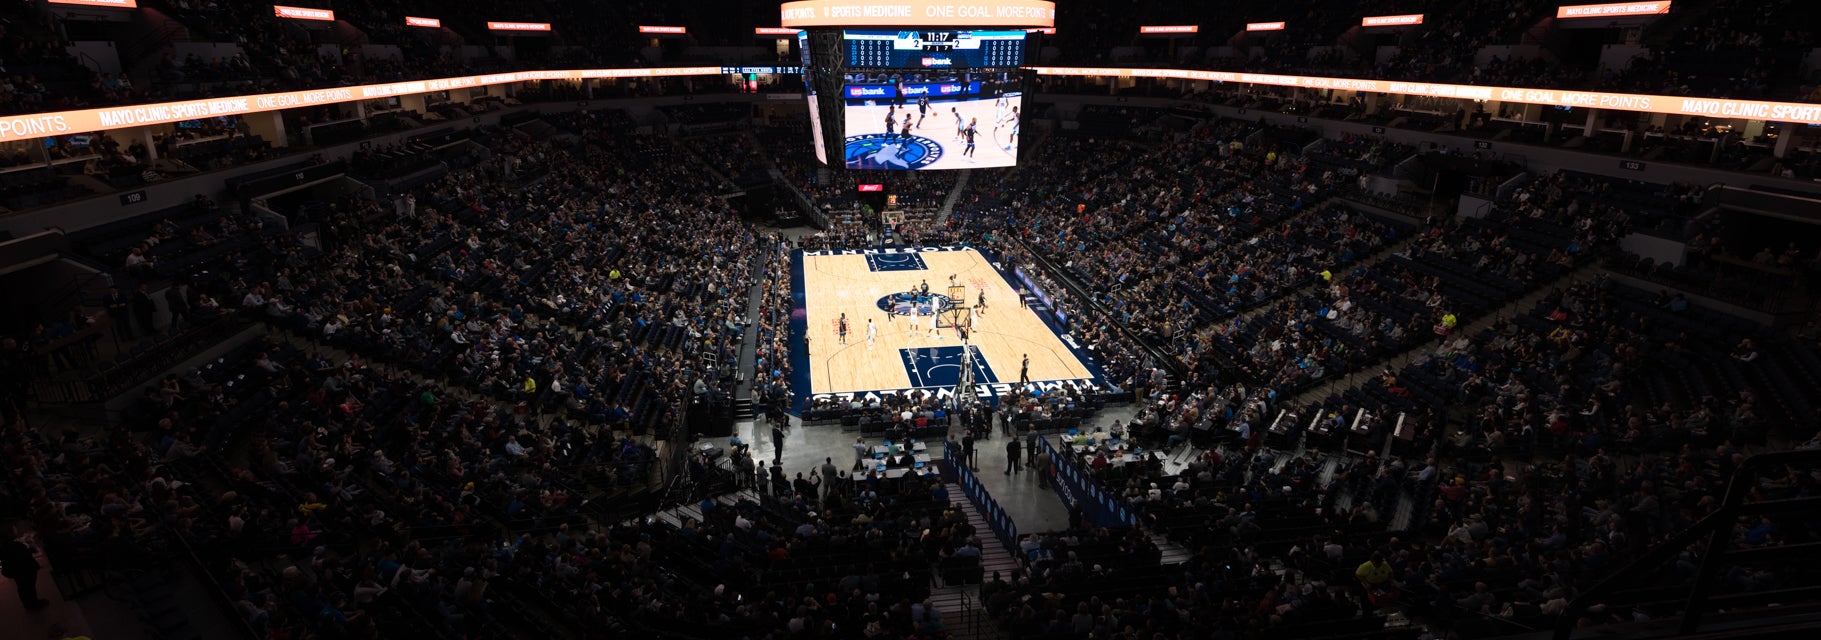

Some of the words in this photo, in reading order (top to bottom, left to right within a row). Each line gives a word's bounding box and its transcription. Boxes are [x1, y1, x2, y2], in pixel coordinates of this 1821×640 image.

[832, 6, 860, 17] SPORTS
[864, 5, 911, 17] MEDICINE
[926, 5, 954, 17] ONE
[961, 5, 993, 17] GOAL.
[996, 6, 1024, 18] MORE
[1566, 7, 1582, 15] MAYO
[1583, 7, 1602, 15] CLINIC
[1602, 5, 1627, 14] SPORTS
[1627, 3, 1660, 13] MEDICINE
[928, 32, 949, 41] 11:17
[914, 40, 919, 48] 2
[955, 40, 960, 48] 2
[1333, 80, 1350, 88] MORE
[1389, 82, 1407, 93] MAYO
[1407, 84, 1428, 95] CLINIC
[1428, 85, 1455, 96] SPORTS
[257, 97, 276, 109] ONE
[278, 94, 302, 107] GOAL.
[304, 92, 325, 105] MORE
[326, 88, 352, 101] POINTS.
[1501, 89, 1523, 101] ONE
[1526, 91, 1558, 103] GOAL.
[1561, 93, 1597, 105] MORE
[1600, 95, 1652, 109] POINTS.
[99, 110, 134, 127] MAYO
[135, 106, 171, 123] CLINIC
[171, 102, 208, 119] SPORTS
[208, 98, 248, 114] MEDICINE
[1681, 100, 1720, 114] MAYO
[1722, 102, 1769, 118] CLINIC
[1771, 105, 1821, 121] SPORT
[0, 116, 71, 138] POINTS.
[1626, 161, 1639, 170] 133
[127, 193, 141, 203] 109
[803, 246, 977, 256] MINNESOTA
